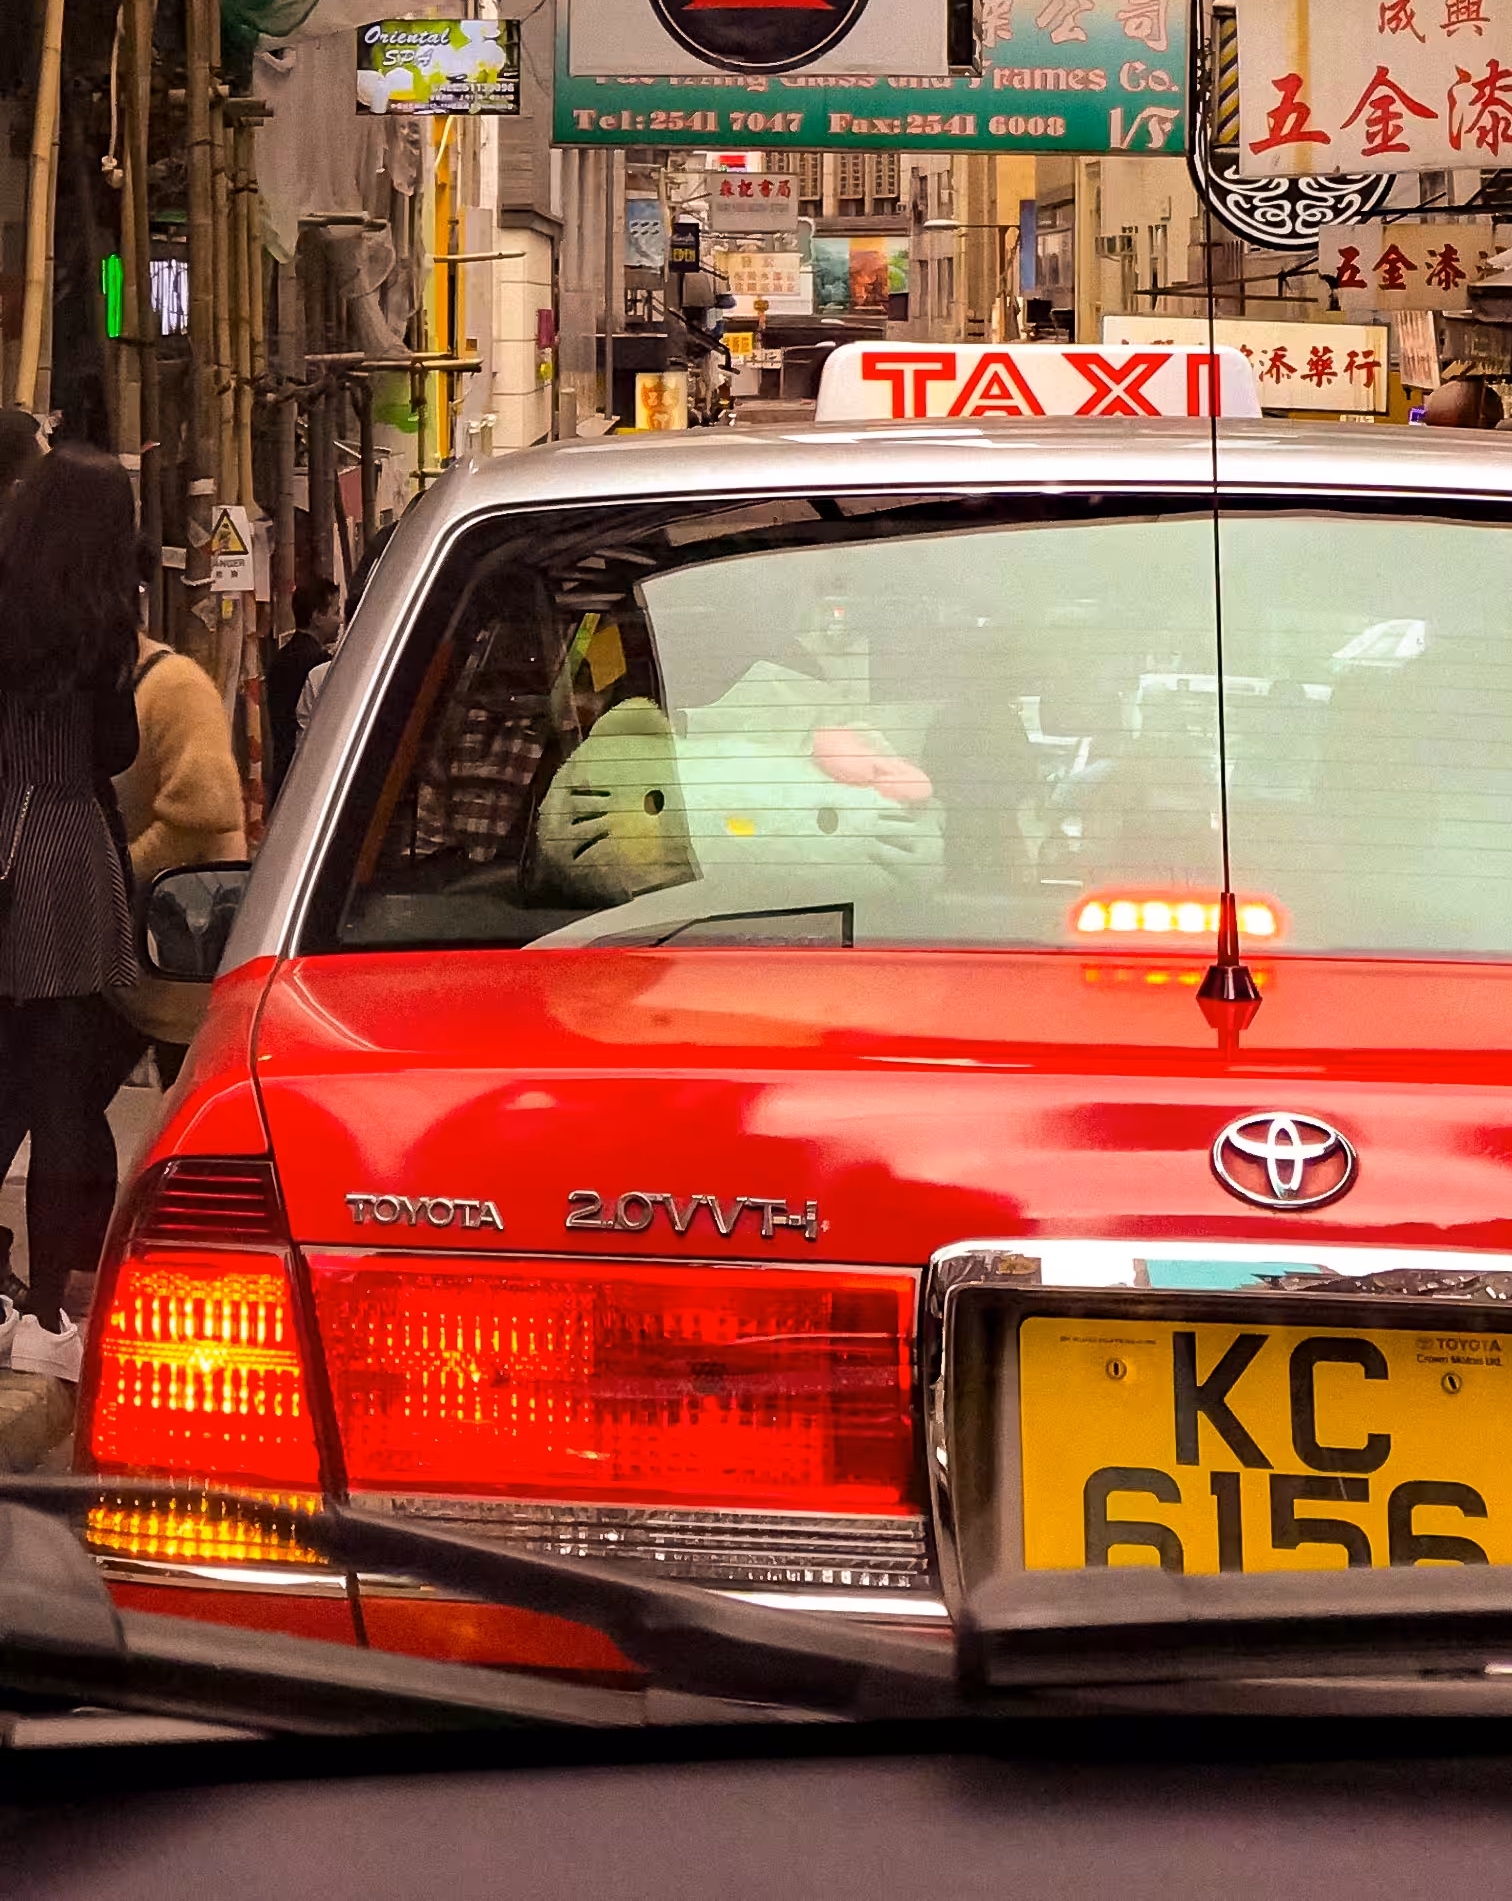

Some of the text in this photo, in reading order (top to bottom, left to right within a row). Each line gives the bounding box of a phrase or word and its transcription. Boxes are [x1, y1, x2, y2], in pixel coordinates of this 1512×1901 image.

[364, 25, 451, 46] Oriental
[1119, 60, 1179, 92] Co.
[729, 110, 804, 132] 7047
[861, 352, 1221, 419] TAXI
[346, 1193, 504, 1231] TOYOTA
[1172, 1331, 1392, 1474] KC
[1083, 1466, 1490, 1574] 6156
